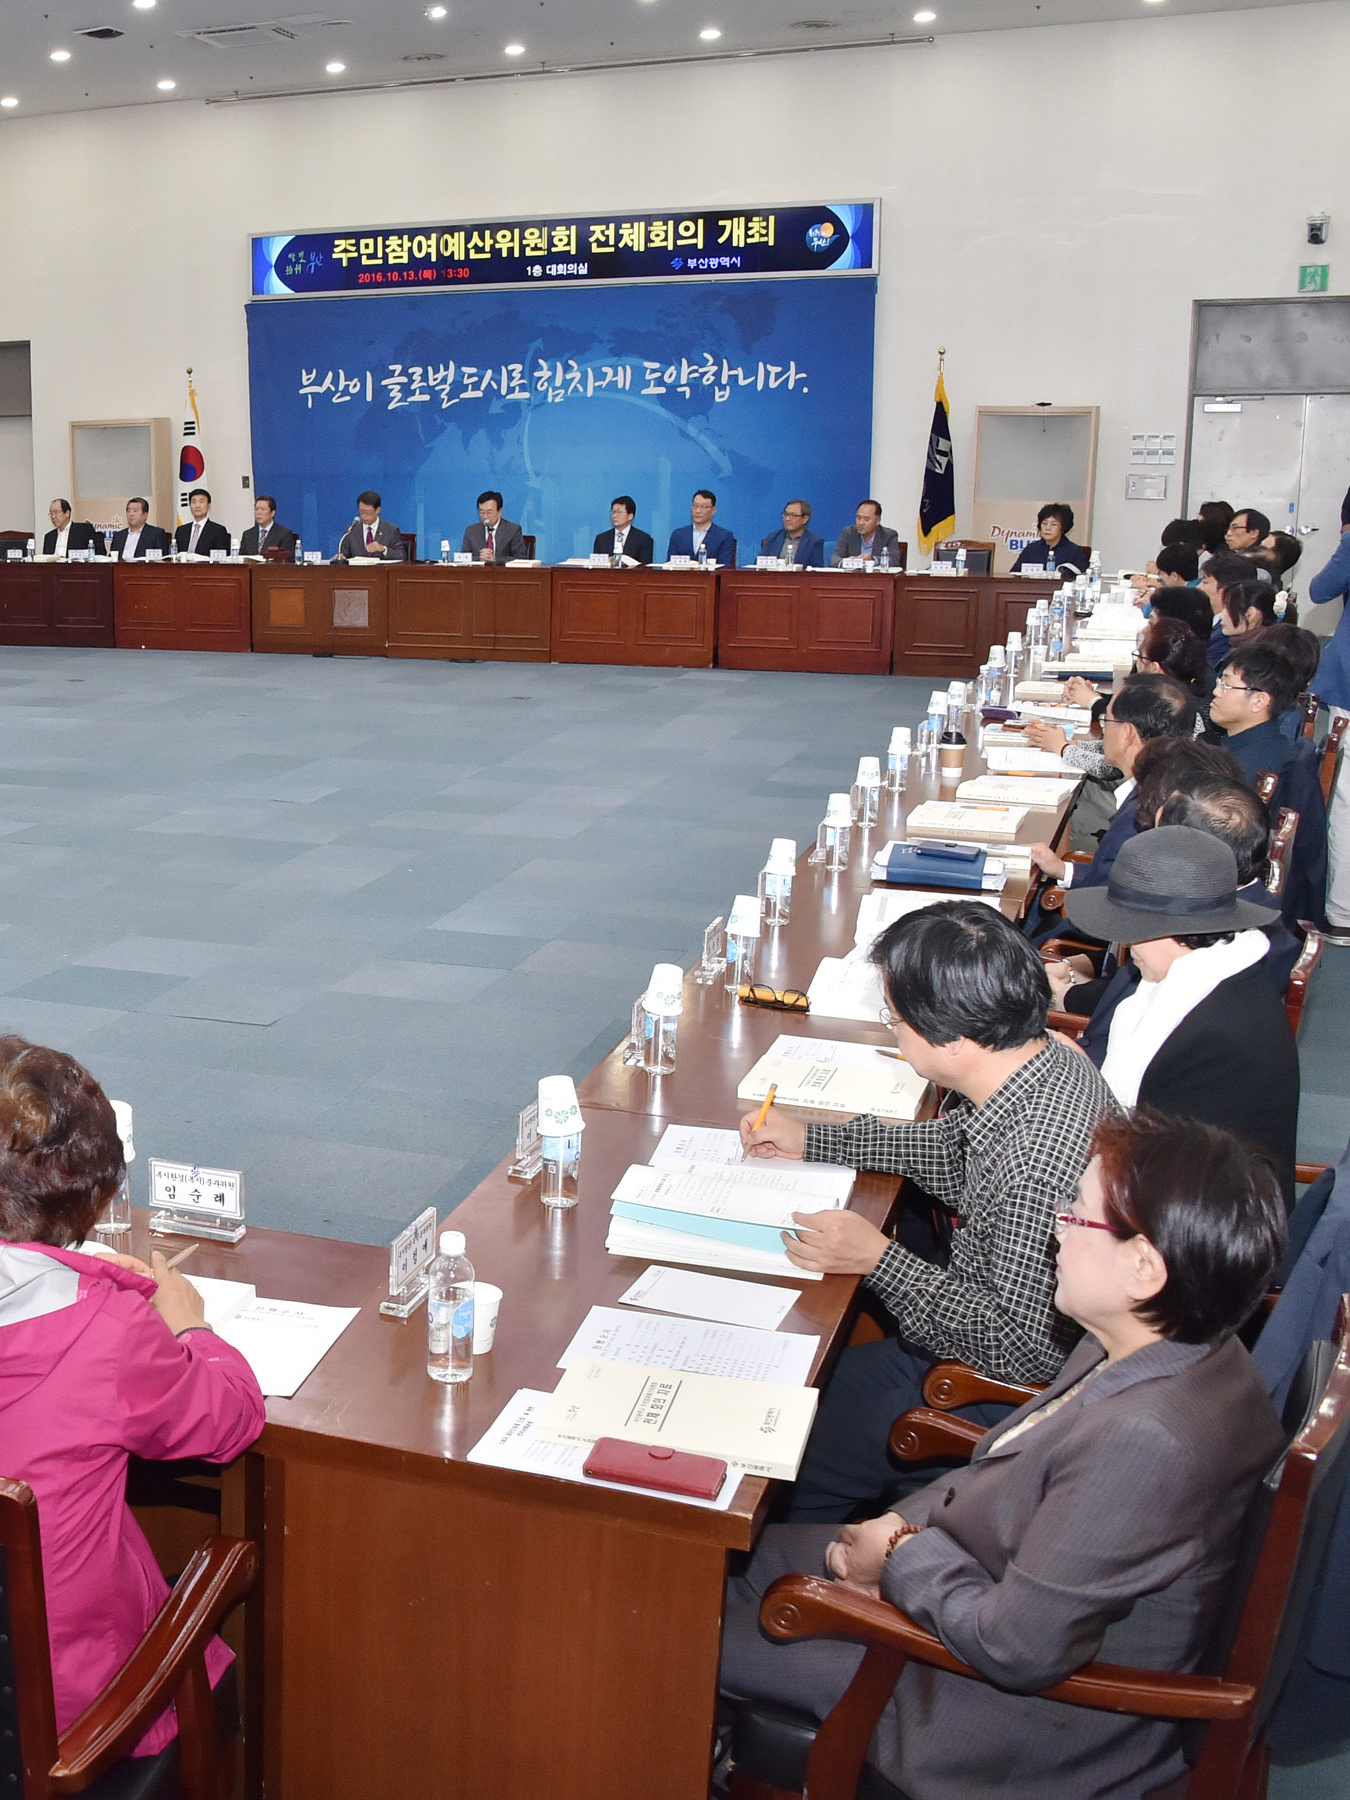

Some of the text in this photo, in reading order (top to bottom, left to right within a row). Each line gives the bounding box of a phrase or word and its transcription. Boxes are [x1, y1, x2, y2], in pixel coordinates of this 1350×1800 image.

[331, 225, 577, 268] 주민참여예산위원회
[588, 219, 704, 254] 전체회의
[717, 215, 775, 249] 개최
[526, 262, 588, 277] 1층 대회의실
[687, 256, 741, 269] 부산광역시
[298, 368, 373, 409] 부산이
[532, 358, 632, 403] 힘차게
[640, 352, 809, 403] 도약합니다.
